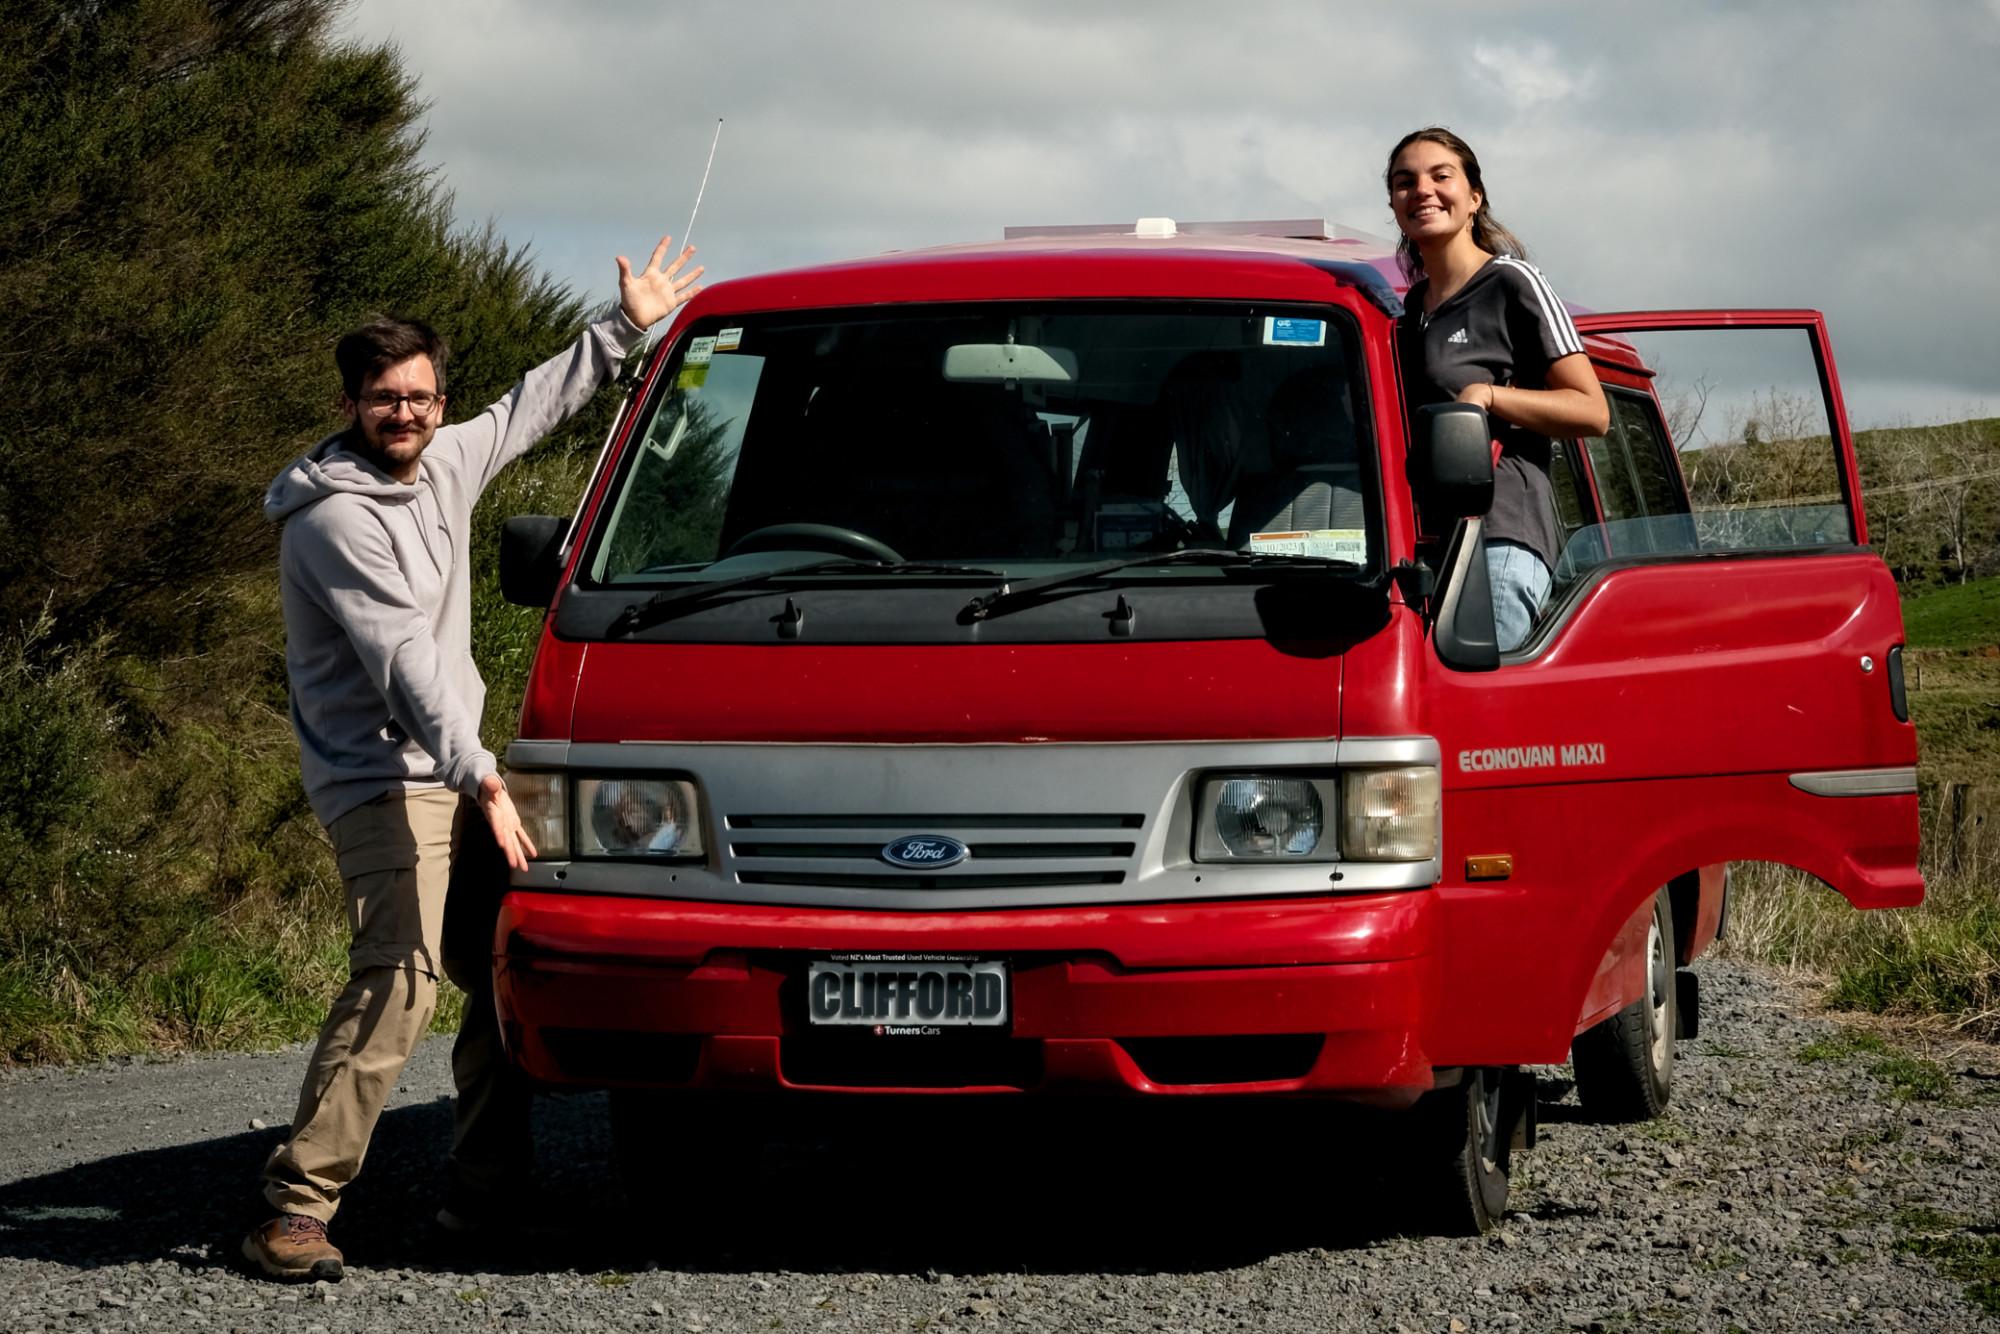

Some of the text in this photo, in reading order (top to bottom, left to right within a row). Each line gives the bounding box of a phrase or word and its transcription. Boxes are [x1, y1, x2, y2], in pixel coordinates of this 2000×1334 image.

[1458, 743, 1606, 773] ECONOVAN MAXI
[902, 841, 947, 859] Ford
[923, 953, 946, 961] Vehicle
[812, 971, 1003, 1019] CLIFFORD
